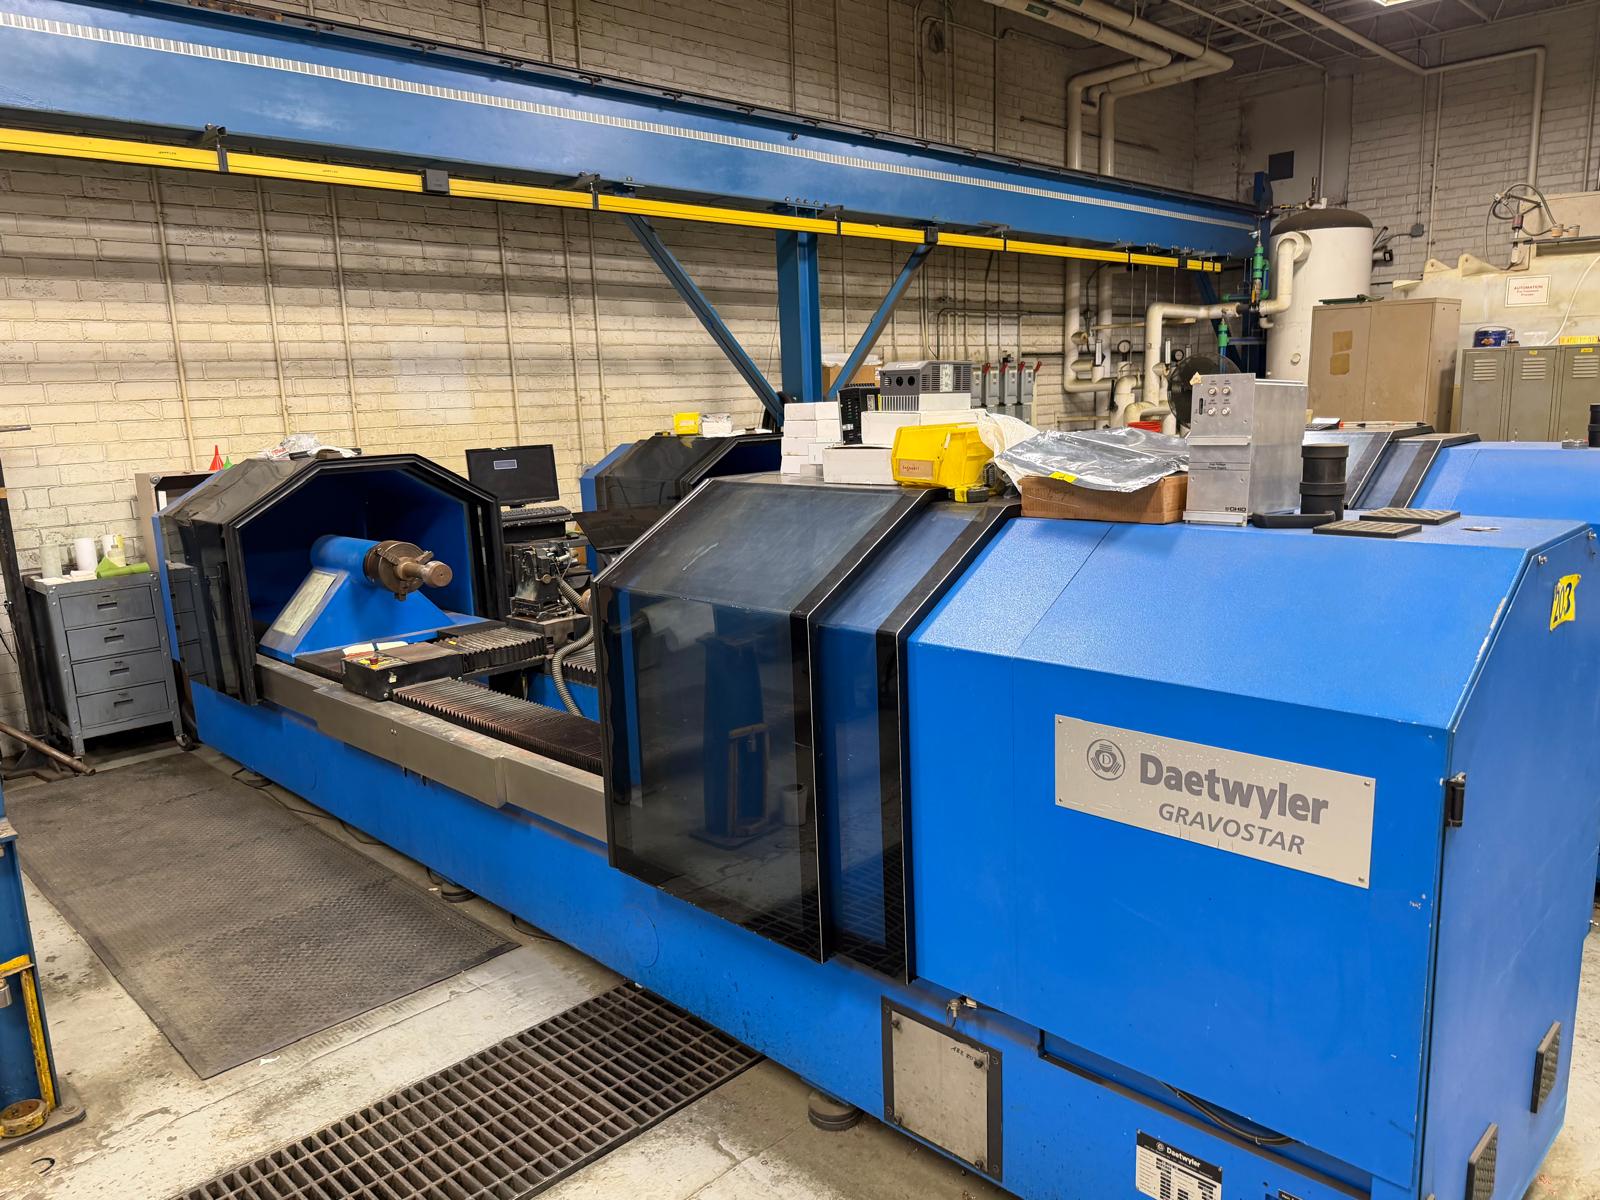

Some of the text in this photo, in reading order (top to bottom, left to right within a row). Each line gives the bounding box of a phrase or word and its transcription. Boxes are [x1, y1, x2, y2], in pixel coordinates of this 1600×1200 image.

[1139, 753, 1329, 824] Daetwyler
[1158, 802, 1305, 855] GRAVOSTAR
[1166, 1147, 1201, 1168] Daetwyler
